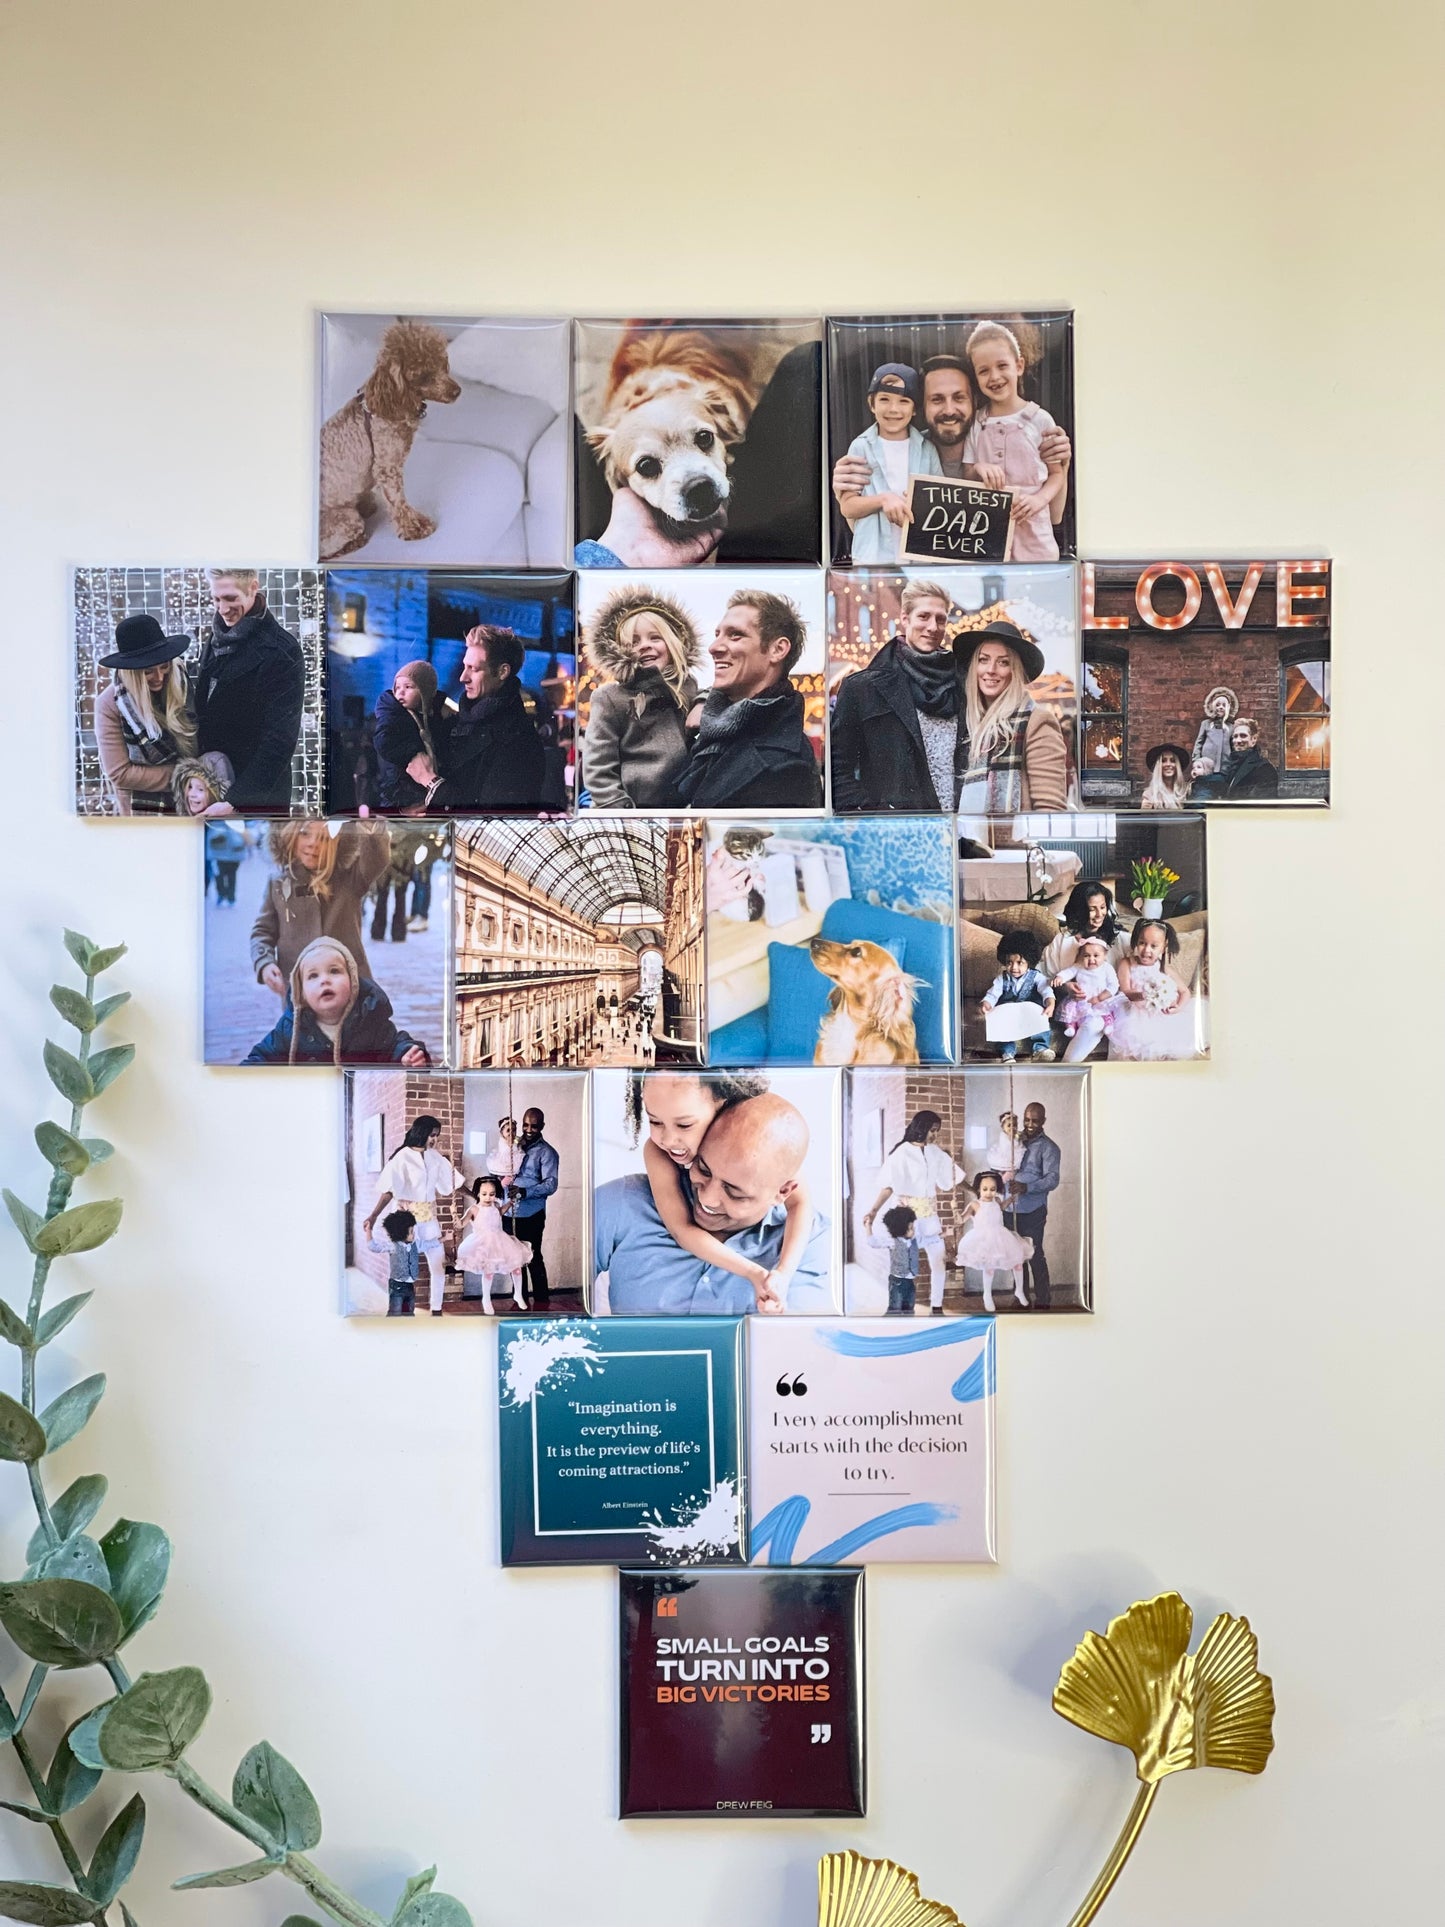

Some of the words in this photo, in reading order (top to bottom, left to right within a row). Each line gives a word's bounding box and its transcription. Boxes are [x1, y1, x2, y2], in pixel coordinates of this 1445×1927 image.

[922, 487, 962, 504] THE
[968, 489, 1010, 509] BEST
[922, 506, 989, 535] DAD
[932, 534, 986, 554] EVER
[1081, 561, 1329, 631] LOVE
[665, 1399, 676, 1412] is
[823, 1410, 964, 1429] accomplishment
[581, 1422, 662, 1438] everything.
[546, 1446, 557, 1457] It
[560, 1445, 571, 1456] is
[574, 1444, 596, 1456] the
[598, 1445, 651, 1458] preview
[654, 1442, 670, 1454] of
[770, 1438, 818, 1454] starts
[823, 1438, 860, 1453] with
[865, 1438, 893, 1453] the
[898, 1437, 968, 1453] decision
[558, 1465, 607, 1478] coming
[844, 1467, 862, 1480] to
[867, 1467, 895, 1484] try.
[656, 1638, 741, 1654] SMALL
[744, 1636, 829, 1653] GOALS
[656, 1659, 746, 1681] TURN
[751, 1658, 830, 1680] INTO
[657, 1686, 697, 1703] BIG
[700, 1685, 831, 1703] VICTORIES
[716, 1801, 749, 1810] DREW
[750, 1801, 773, 1809] FEIG
